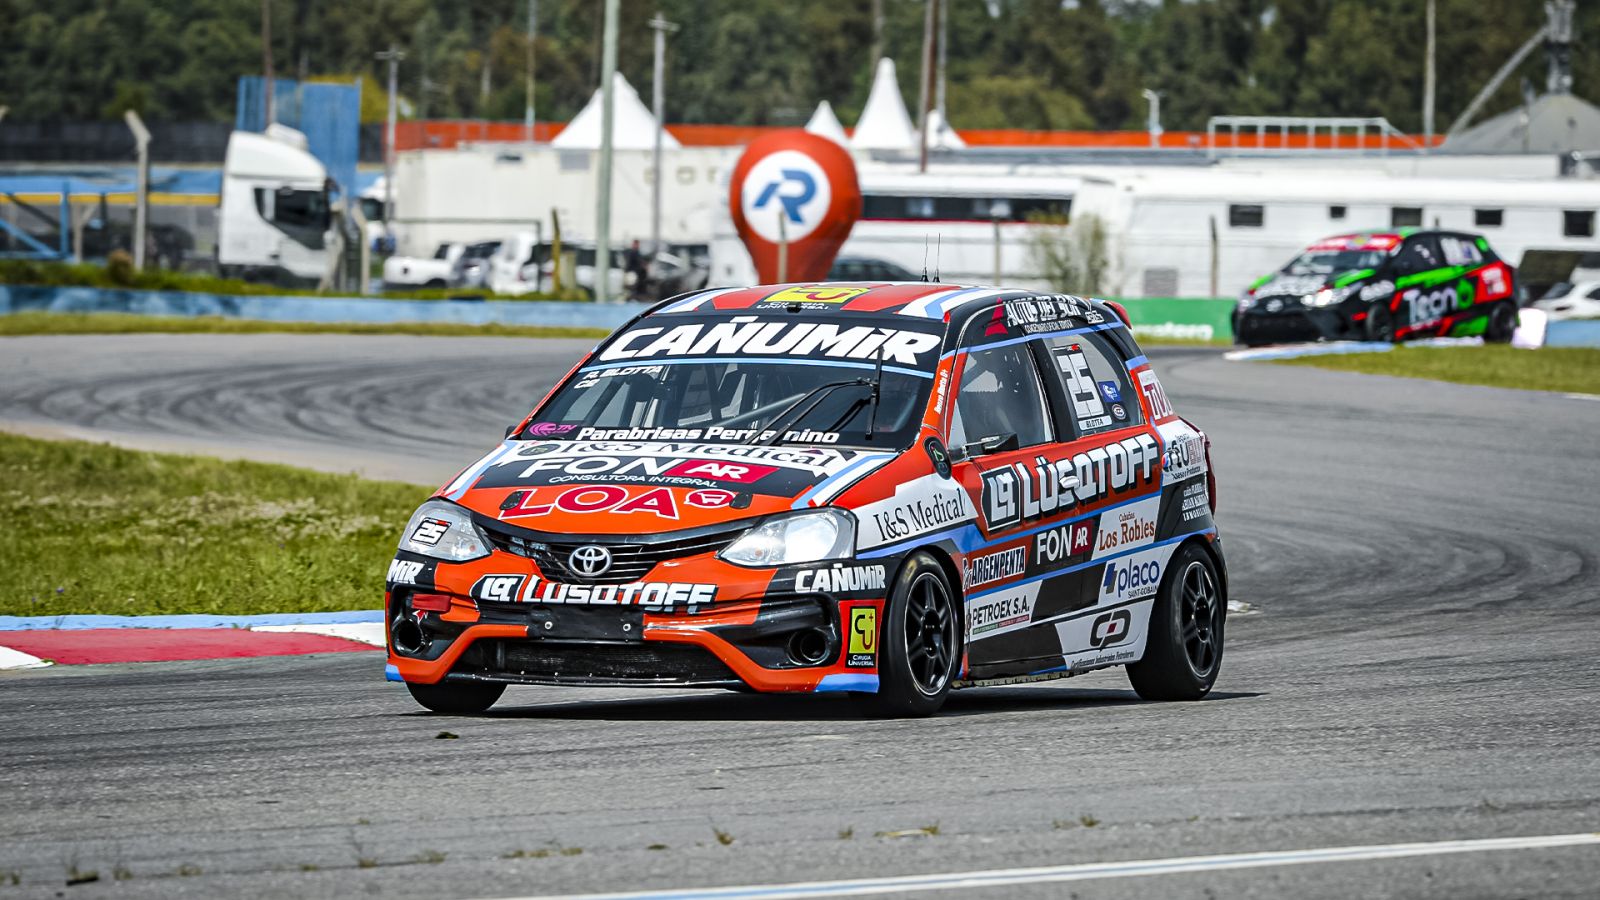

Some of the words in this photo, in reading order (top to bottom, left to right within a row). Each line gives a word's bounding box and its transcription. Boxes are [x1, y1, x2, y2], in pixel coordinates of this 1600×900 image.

[599, 365, 664, 378] BLOTTA
[576, 427, 704, 441] Parabrisas
[518, 456, 687, 479] FON
[690, 463, 750, 480] AR
[651, 443, 836, 468] Medical
[549, 474, 646, 484] CONSULTORA
[648, 474, 718, 488] INTEGRAL
[498, 485, 679, 520] LOA
[873, 507, 909, 541] I&S
[906, 487, 965, 532] Medical
[411, 520, 449, 545] 25
[1036, 524, 1073, 565] FON
[1074, 526, 1088, 549] AR
[1098, 529, 1118, 551] Los
[1120, 517, 1155, 545] Robles
[970, 547, 1025, 587] ARGENPENTA
[1118, 558, 1159, 598] placo
[972, 599, 1012, 627] PETROEX
[1013, 595, 1030, 615] S.A.
